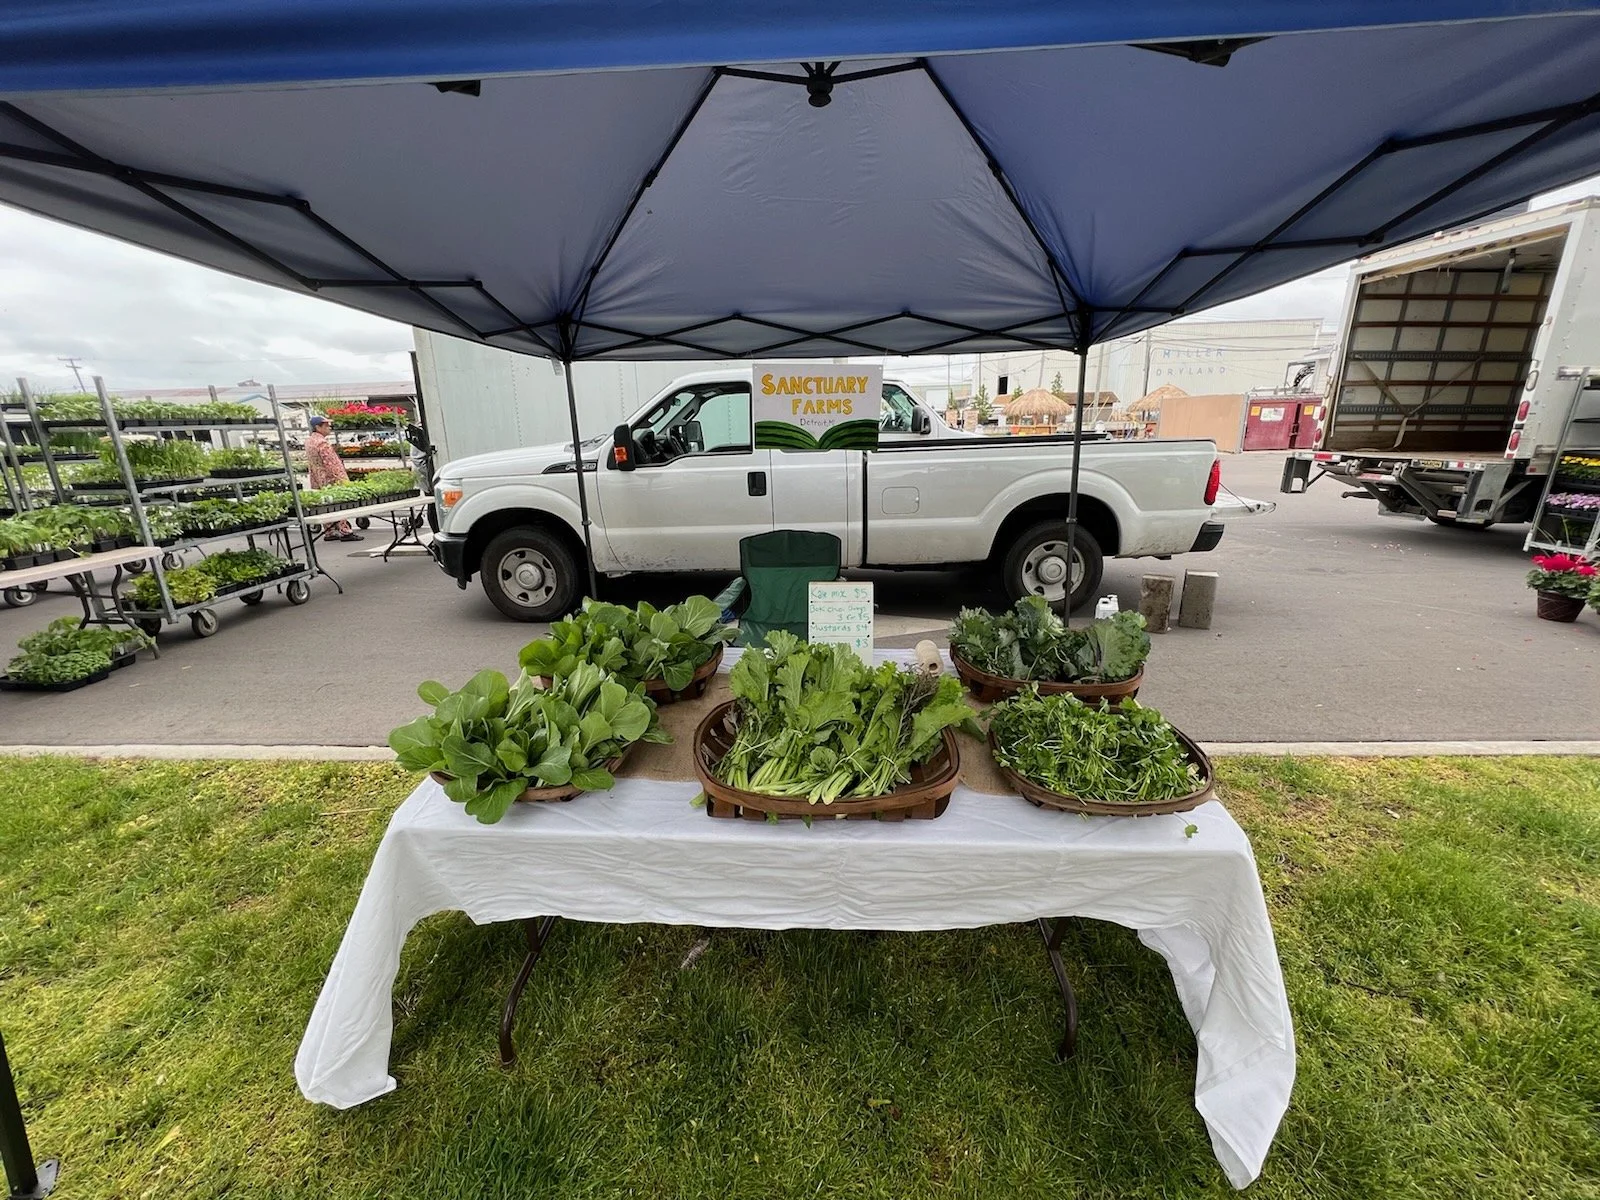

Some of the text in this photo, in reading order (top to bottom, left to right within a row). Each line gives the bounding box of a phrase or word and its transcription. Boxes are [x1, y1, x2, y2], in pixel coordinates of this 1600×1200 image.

[1163, 348, 1223, 358] MILLER
[1156, 367, 1225, 376] DRYLAND
[761, 373, 869, 395] SANCTUARY
[791, 398, 853, 415] FARMS
[831, 590, 847, 598] mix
[854, 588, 868, 599] $5
[811, 624, 851, 632] Mustards
